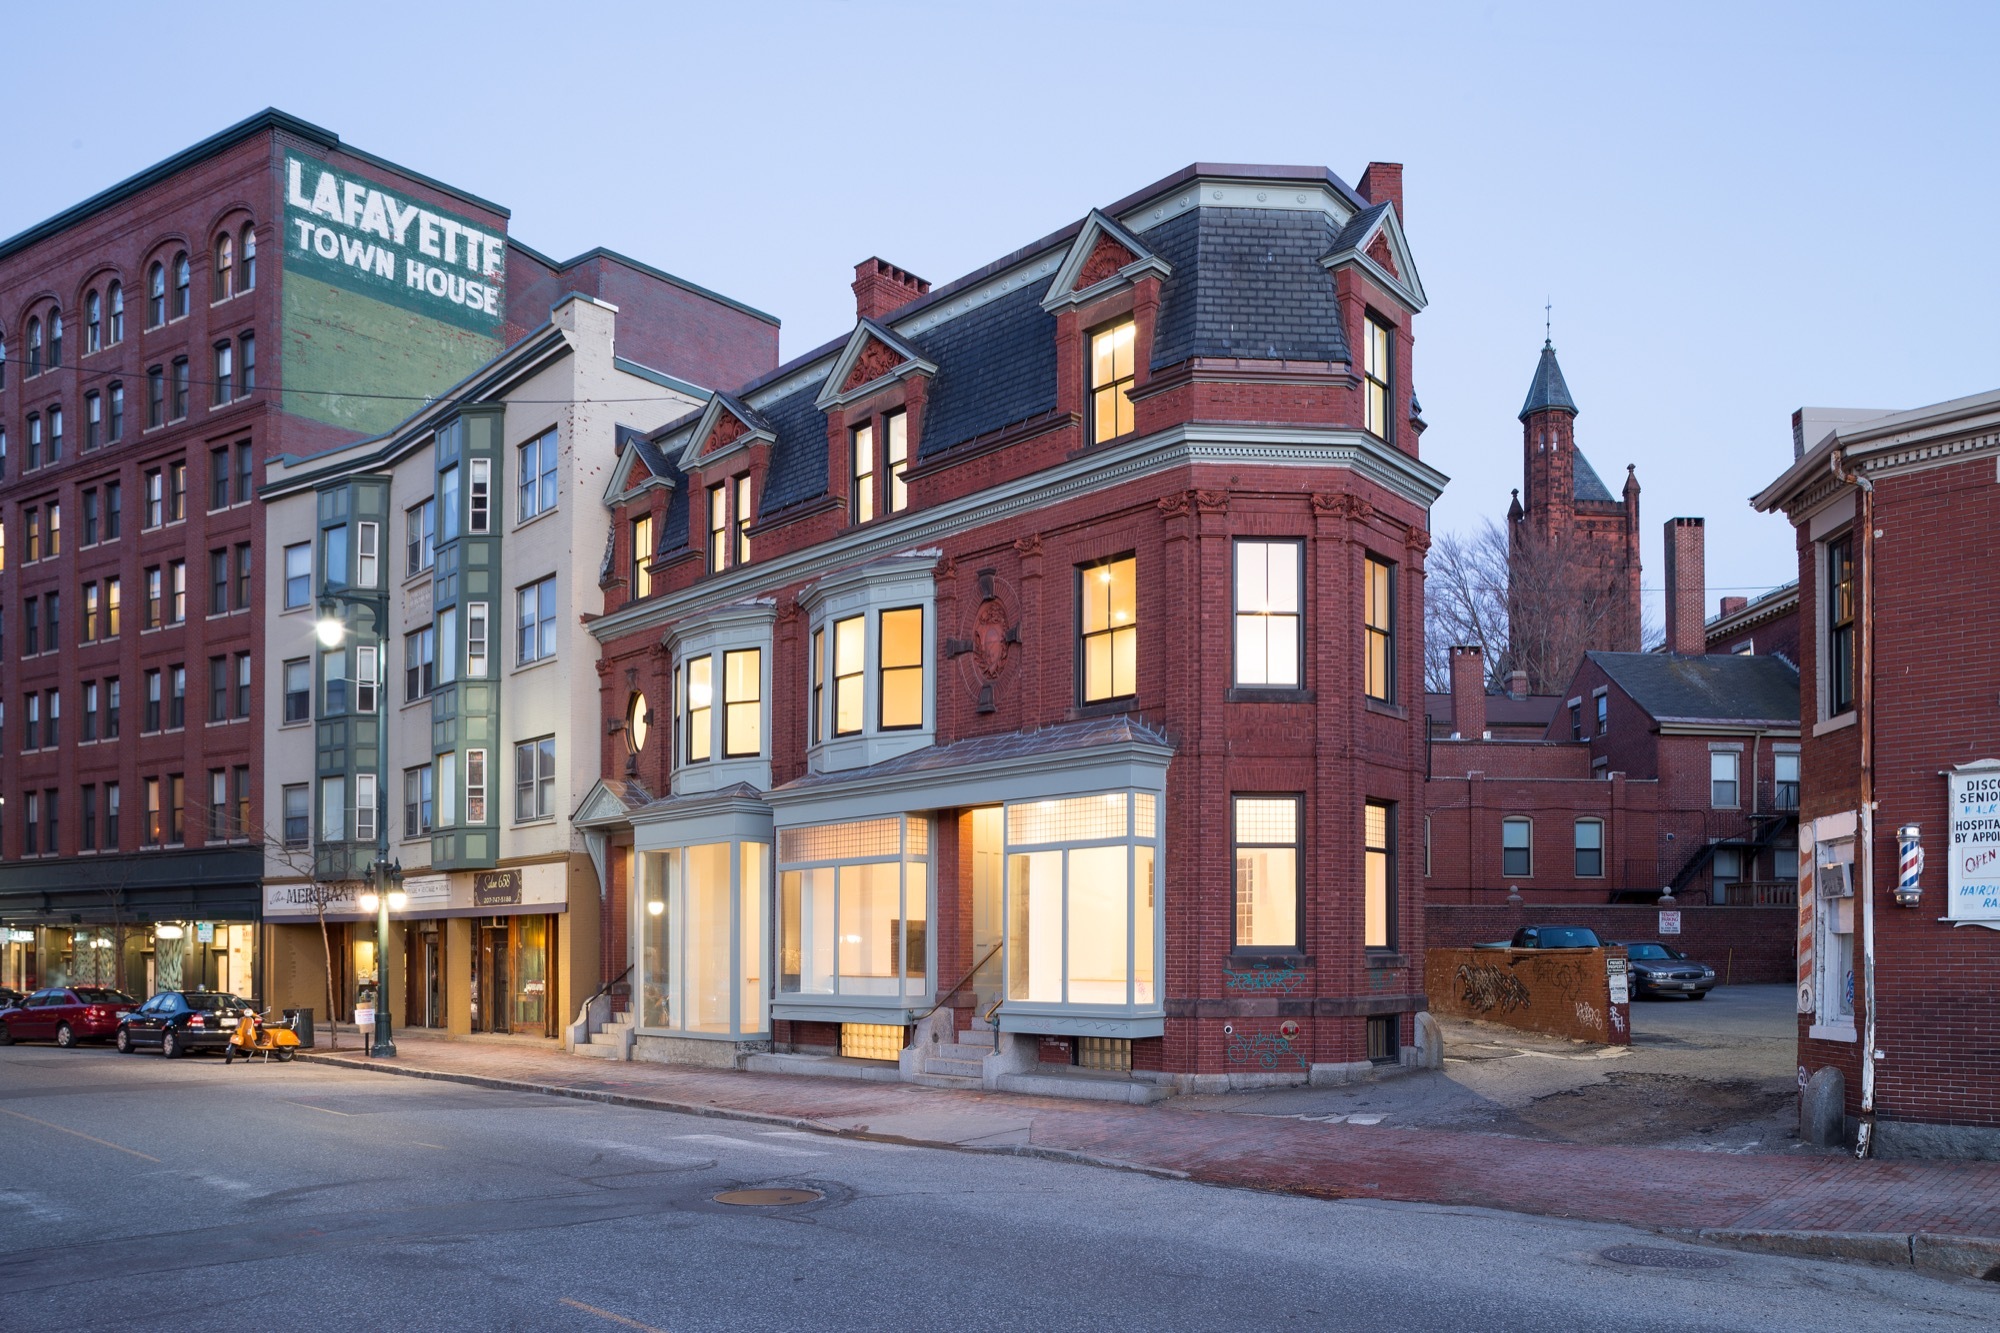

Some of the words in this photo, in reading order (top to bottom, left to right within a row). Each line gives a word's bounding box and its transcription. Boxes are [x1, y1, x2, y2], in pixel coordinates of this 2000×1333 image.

[287, 156, 504, 278] LAFAYETTE
[294, 217, 395, 281] TOWN
[406, 258, 498, 317] HOUSE
[1967, 779, 2000, 791] DISC
[1960, 791, 2000, 803] SENIO
[1955, 832, 1968, 843] BY
[1965, 849, 1997, 873] OPEN
[498, 874, 511, 888] 658
[1982, 898, 2000, 908] RA
